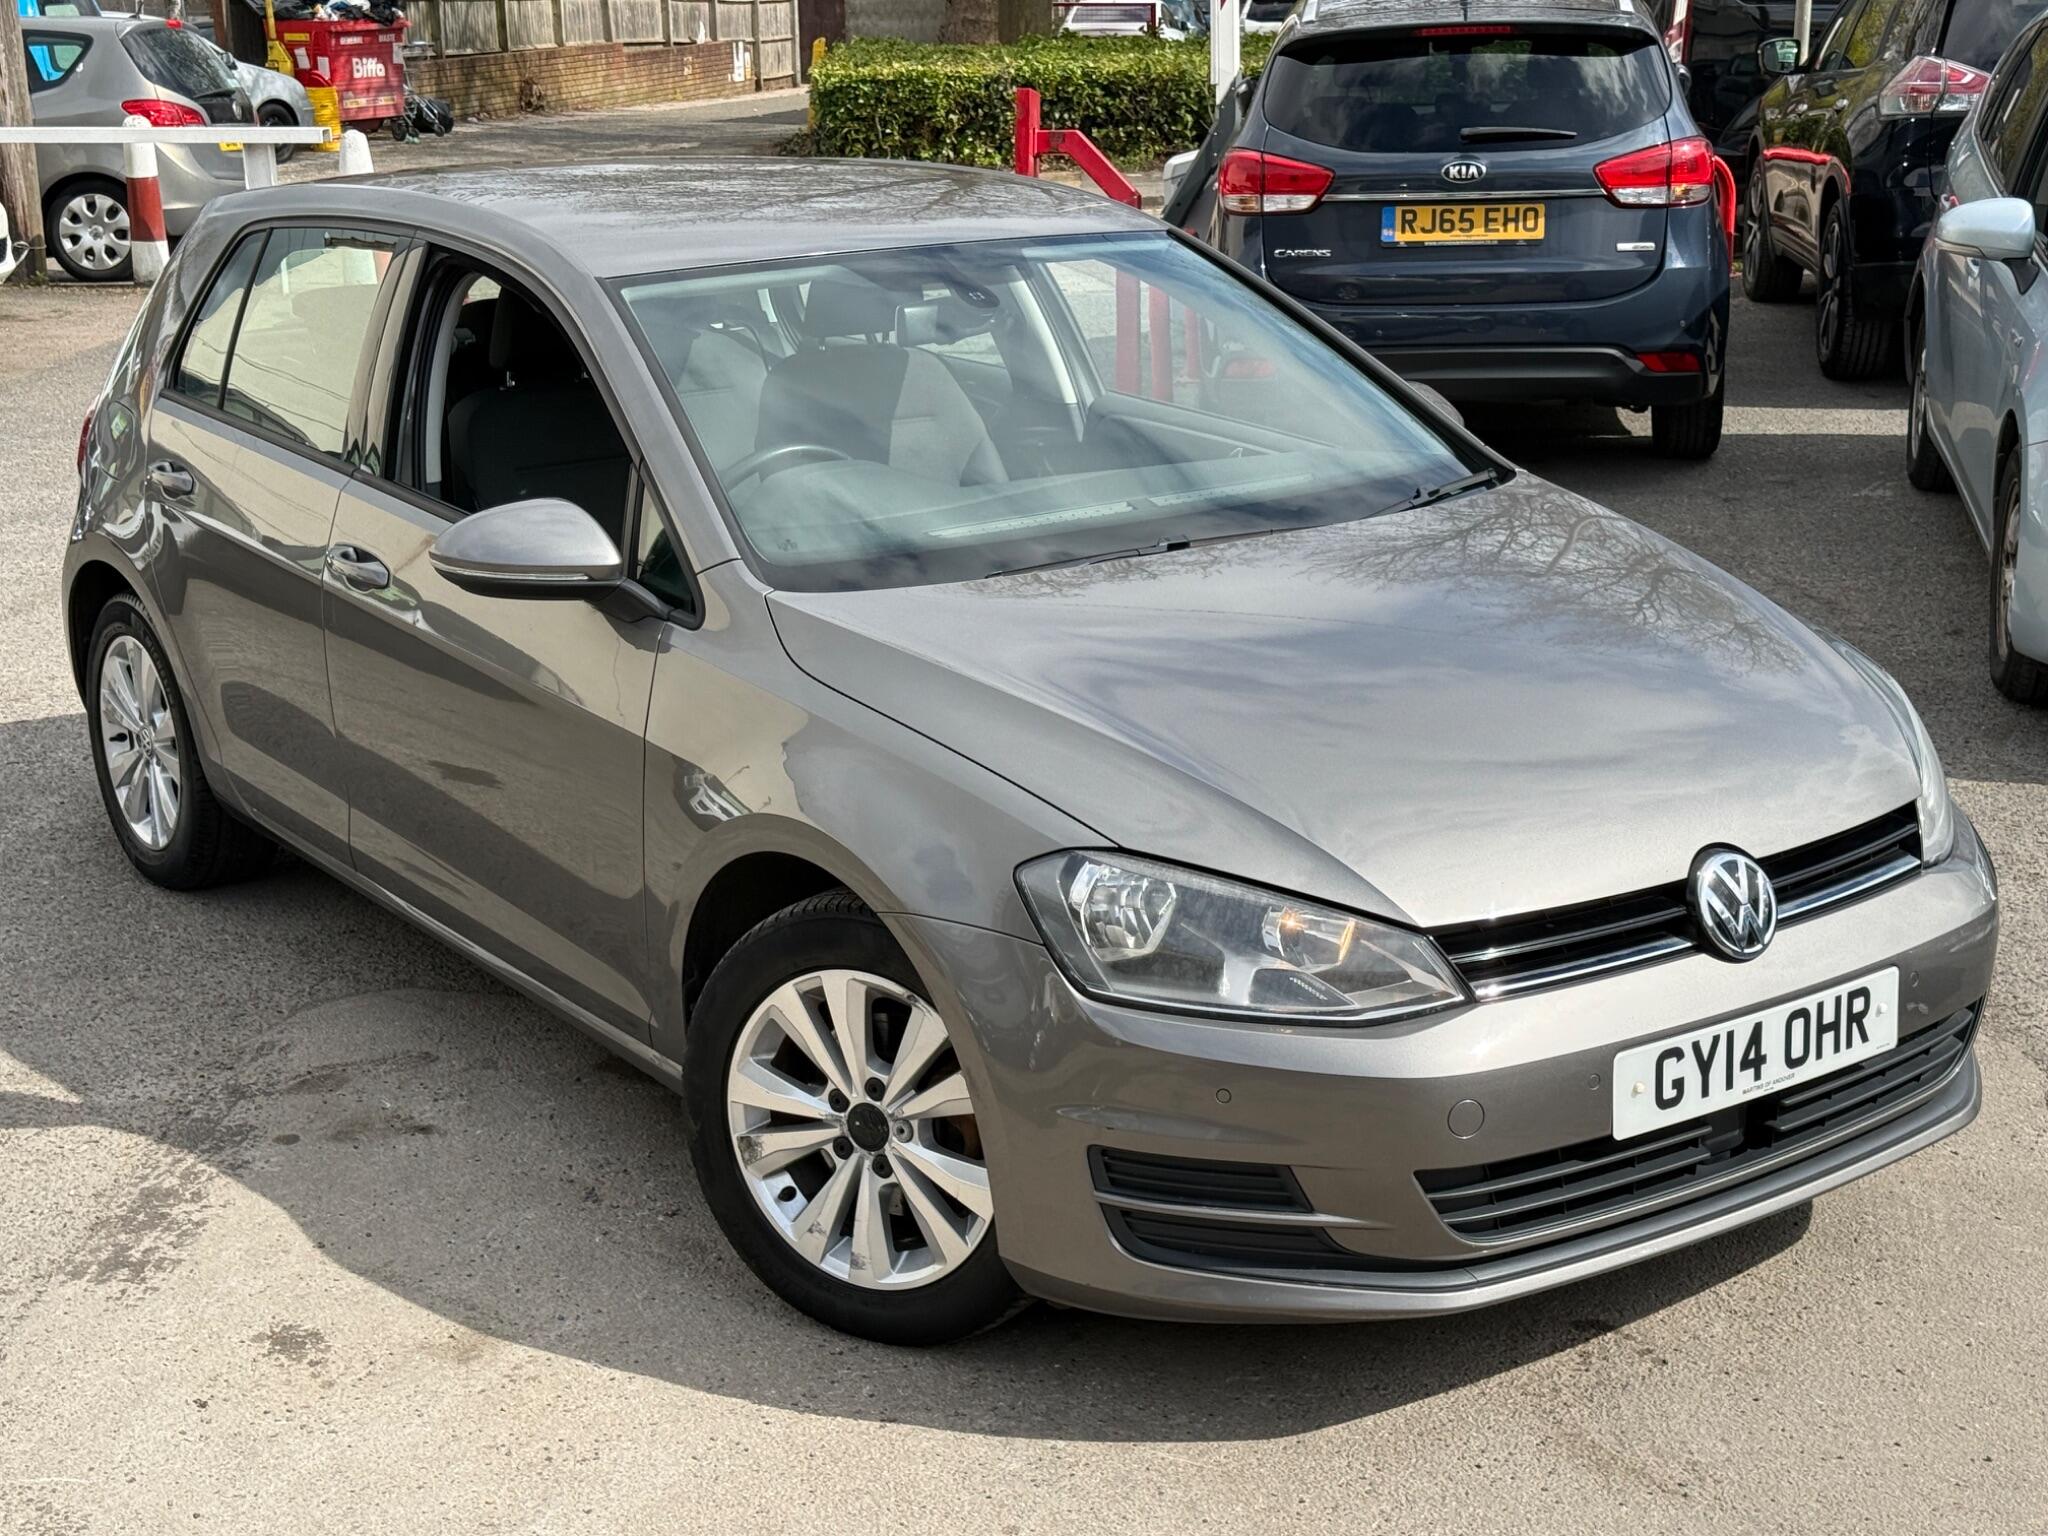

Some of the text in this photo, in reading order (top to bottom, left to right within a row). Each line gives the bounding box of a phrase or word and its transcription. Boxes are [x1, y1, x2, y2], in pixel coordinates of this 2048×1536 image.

[352, 57, 386, 78] Biffa
[1449, 165, 1479, 179] KIA
[1400, 206, 1540, 235] RJ65 EHO
[1273, 249, 1332, 258] CARENS
[1655, 986, 1871, 1111] GY14 OHR
